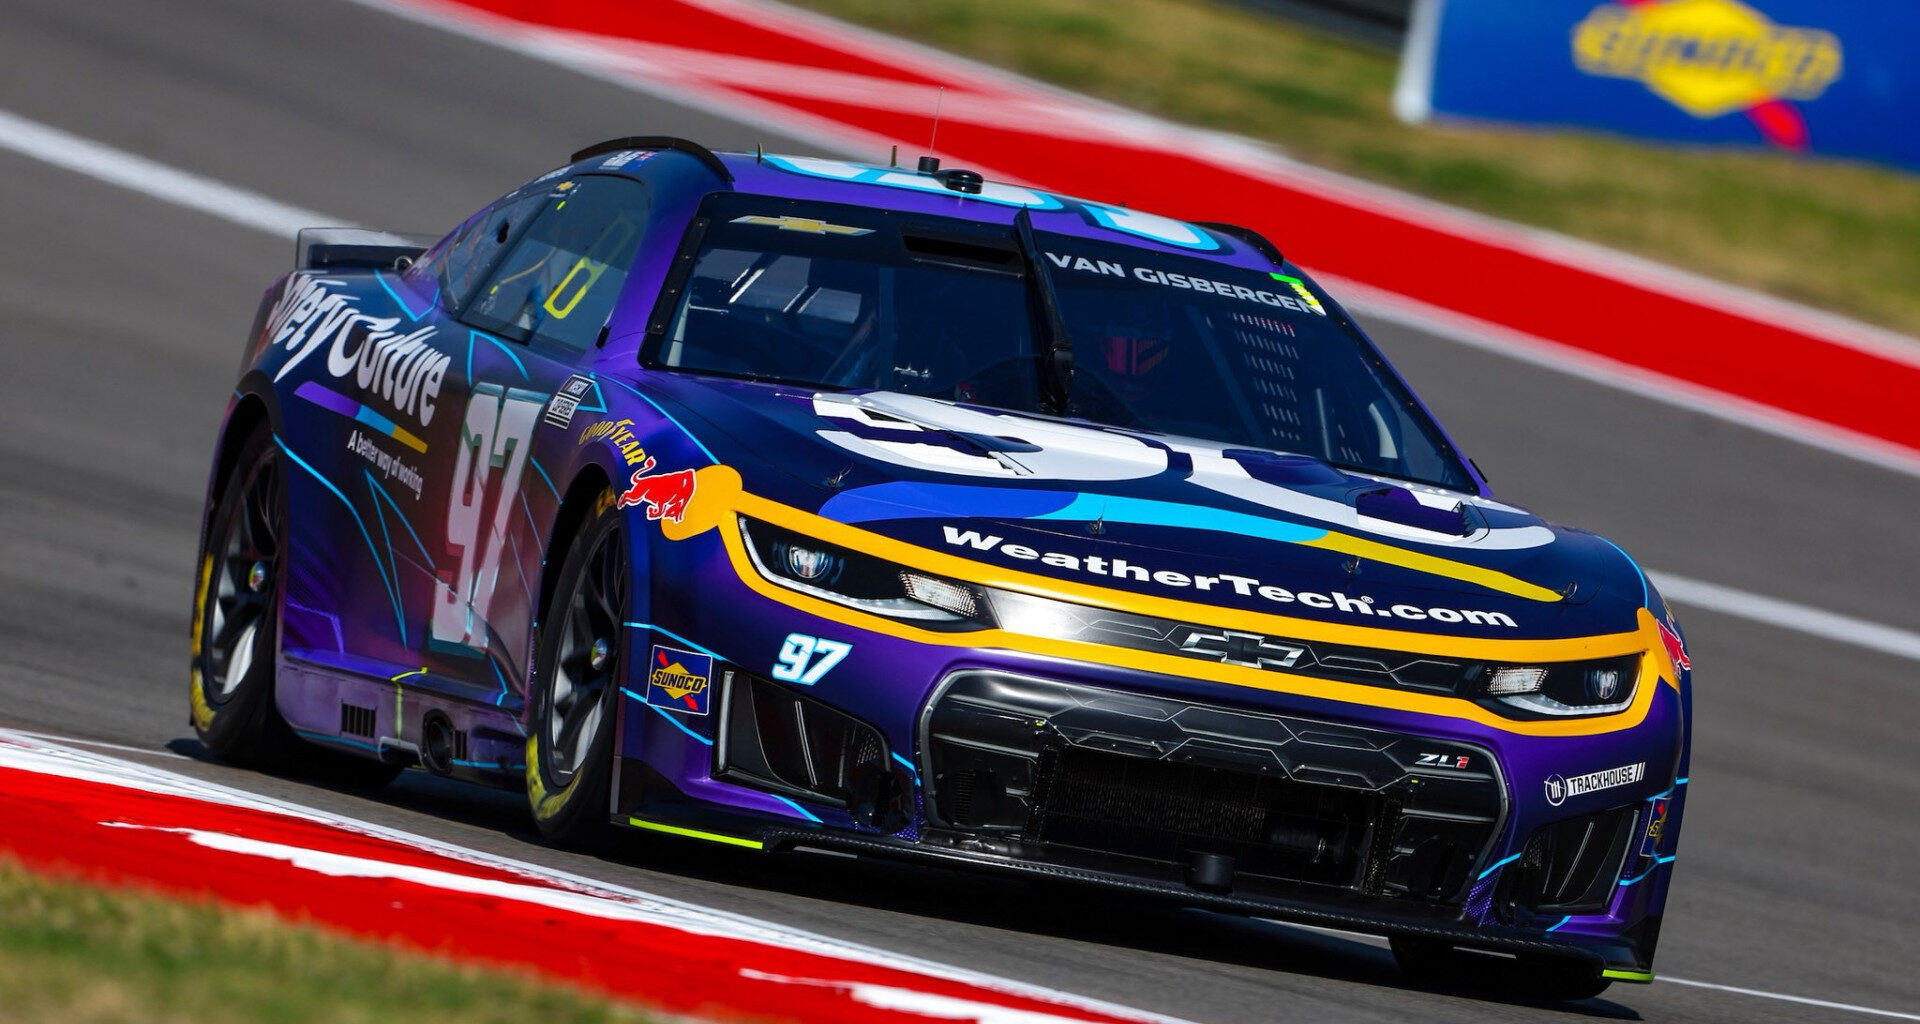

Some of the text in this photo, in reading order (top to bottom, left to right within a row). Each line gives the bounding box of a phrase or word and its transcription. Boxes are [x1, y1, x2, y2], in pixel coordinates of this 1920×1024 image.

[1045, 252, 1126, 278] VAN
[579, 419, 646, 467] GOODYEAR
[347, 429, 358, 451] A
[356, 431, 379, 463] better
[376, 448, 393, 479] way
[398, 463, 424, 501] working
[430, 384, 548, 657] 97
[772, 632, 854, 687] 97
[653, 670, 704, 693] SUNOCO
[1414, 752, 1470, 769] ZL1
[1570, 765, 1634, 794] TRACKHOUSE
